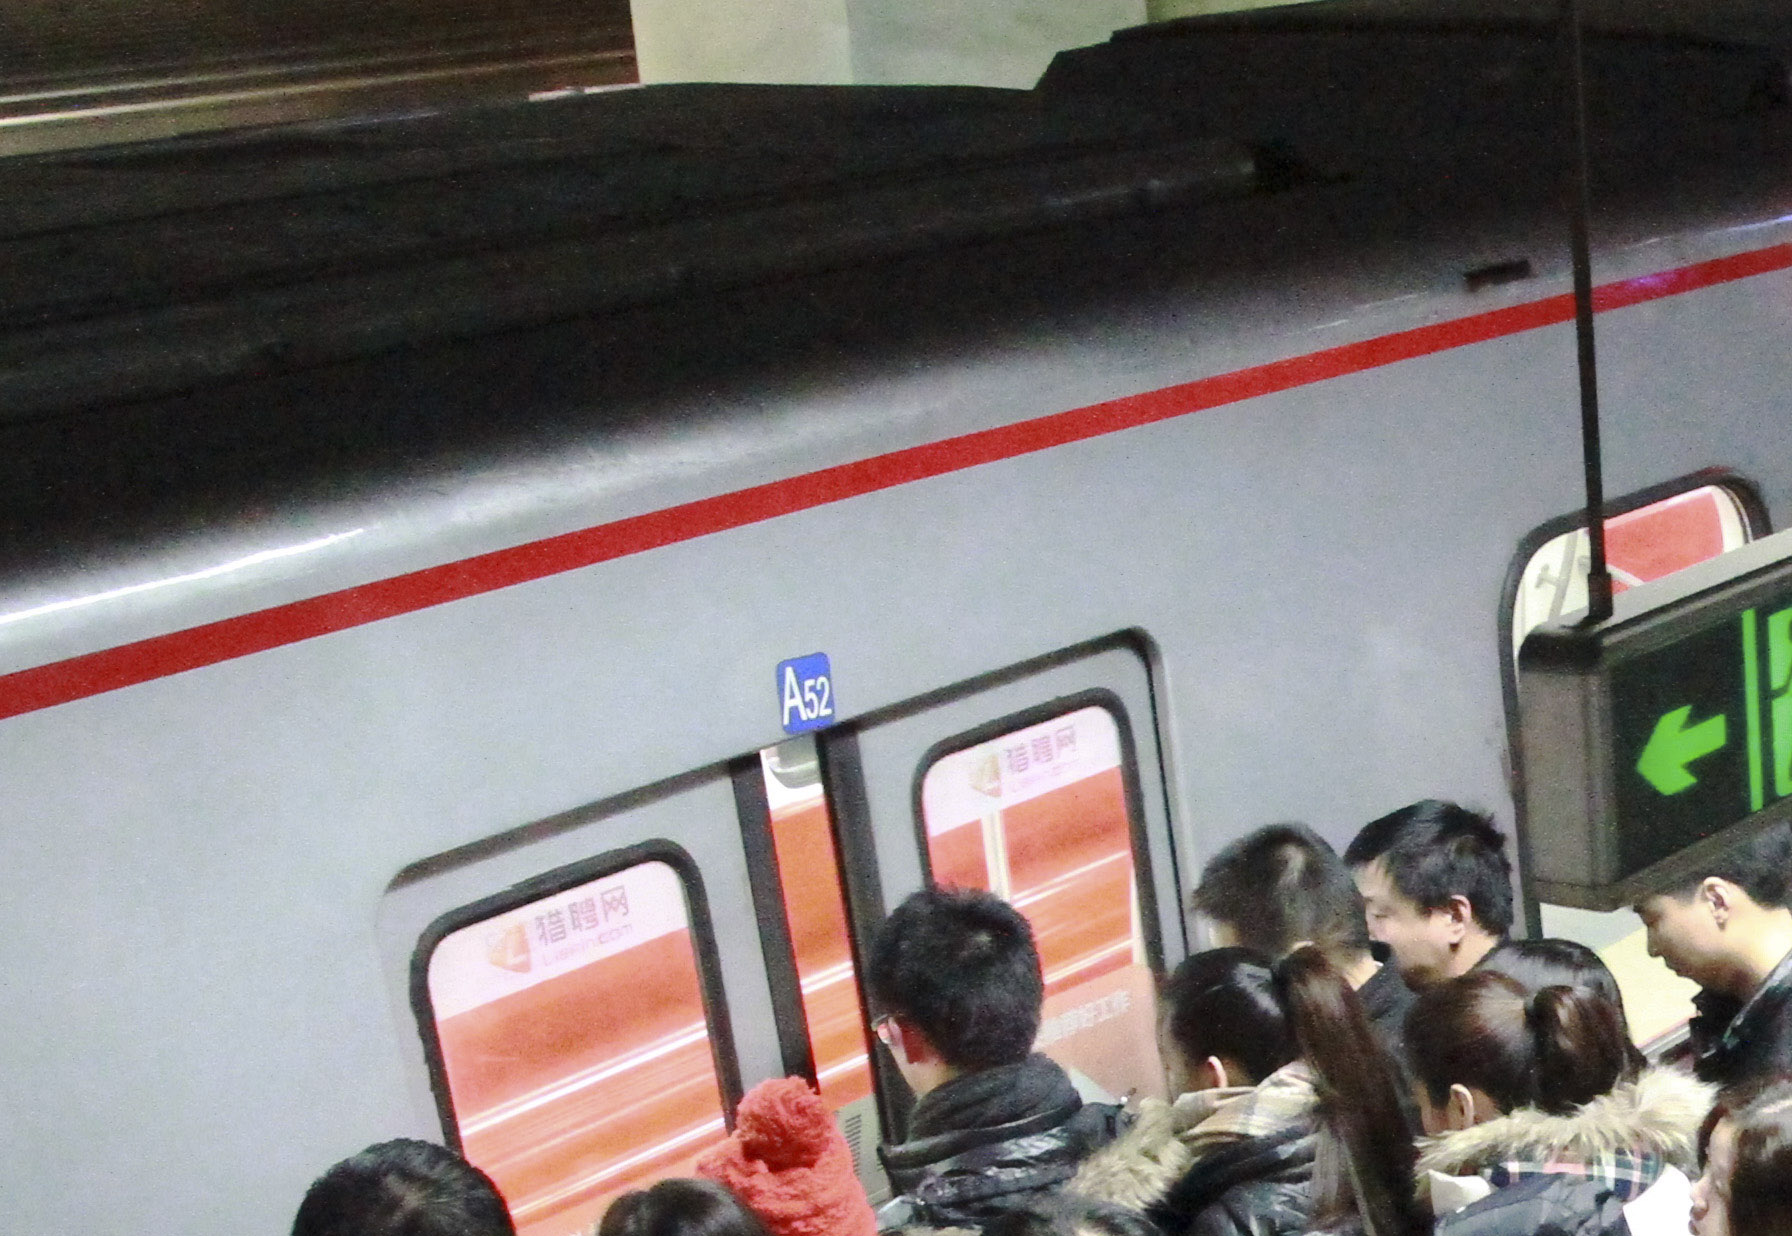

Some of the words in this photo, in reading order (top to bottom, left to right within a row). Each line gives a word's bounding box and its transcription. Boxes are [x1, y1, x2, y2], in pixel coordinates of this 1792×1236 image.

[783, 666, 832, 725] A52
[535, 885, 630, 946] 猎聘网
